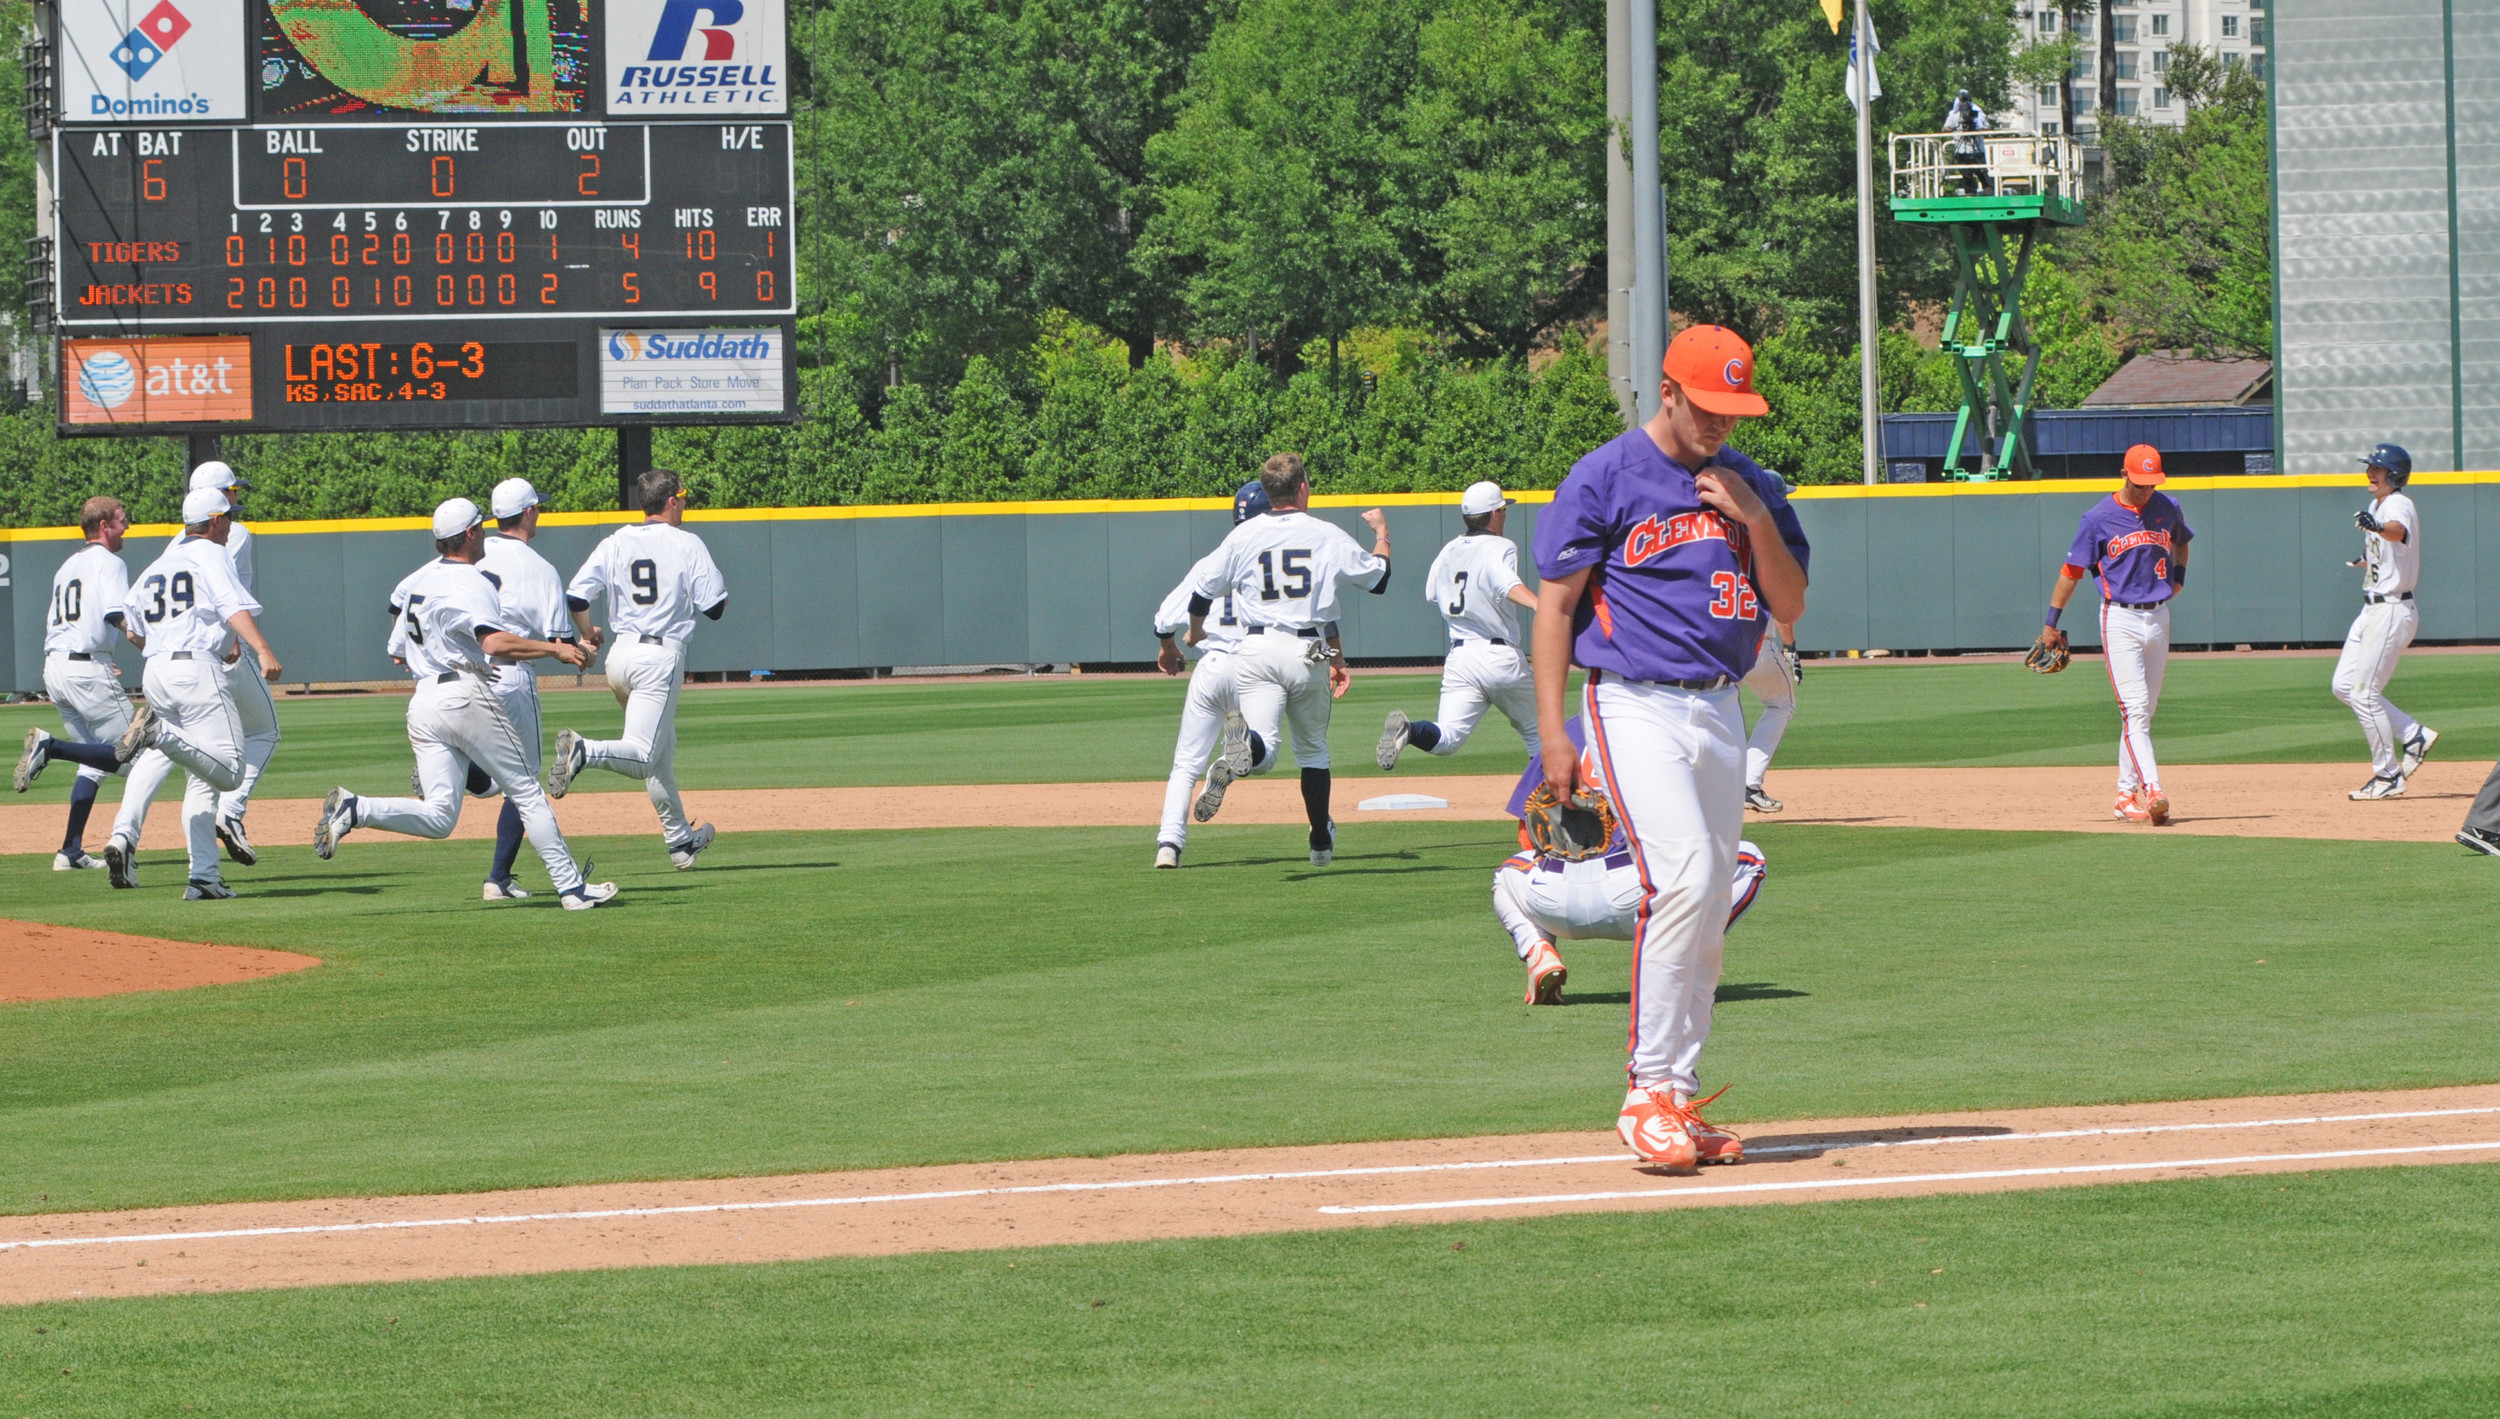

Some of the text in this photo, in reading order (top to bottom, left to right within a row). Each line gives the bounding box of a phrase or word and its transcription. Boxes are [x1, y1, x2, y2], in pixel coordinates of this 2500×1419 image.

[620, 65, 777, 88] RUSSELL
[91, 93, 209, 116] Domino's
[615, 90, 774, 105] ATHLETIC
[92, 131, 183, 157] AT BAT
[266, 129, 324, 154] BALL
[406, 128, 479, 153] STRIKE
[566, 127, 608, 151] OUT
[721, 126, 764, 150] H/E
[143, 159, 167, 201] 6
[283, 157, 307, 199] 0
[431, 155, 455, 197] 0
[578, 154, 600, 196] 2
[230, 206, 782, 233] 1 2 3 4 5 6 7 8 9 10 RUNS HITS ERR
[88, 229, 774, 267] TIGERS 0 1 0 0 2 0 0 0 0 1 4 10 1
[79, 270, 774, 309] JACKETS 2 0 0 0 1 0 0 0 0 2 5 9 0
[644, 333, 770, 360] Suddath
[145, 356, 233, 396] at&t
[622, 375, 761, 390] Plan Pack Store Move
[1723, 358, 1744, 386] C
[632, 398, 747, 411] suddathatlanta.com
[2142, 458, 2154, 472] C
[2106, 528, 2172, 560] CLEMSON
[630, 559, 659, 605] 9
[1258, 548, 1313, 601] 15
[2154, 557, 2168, 580] 4
[52, 578, 83, 627] 10
[143, 571, 196, 623] 39
[1449, 571, 1469, 616] 3
[1708, 570, 1758, 621] 32
[405, 594, 426, 646] 5
